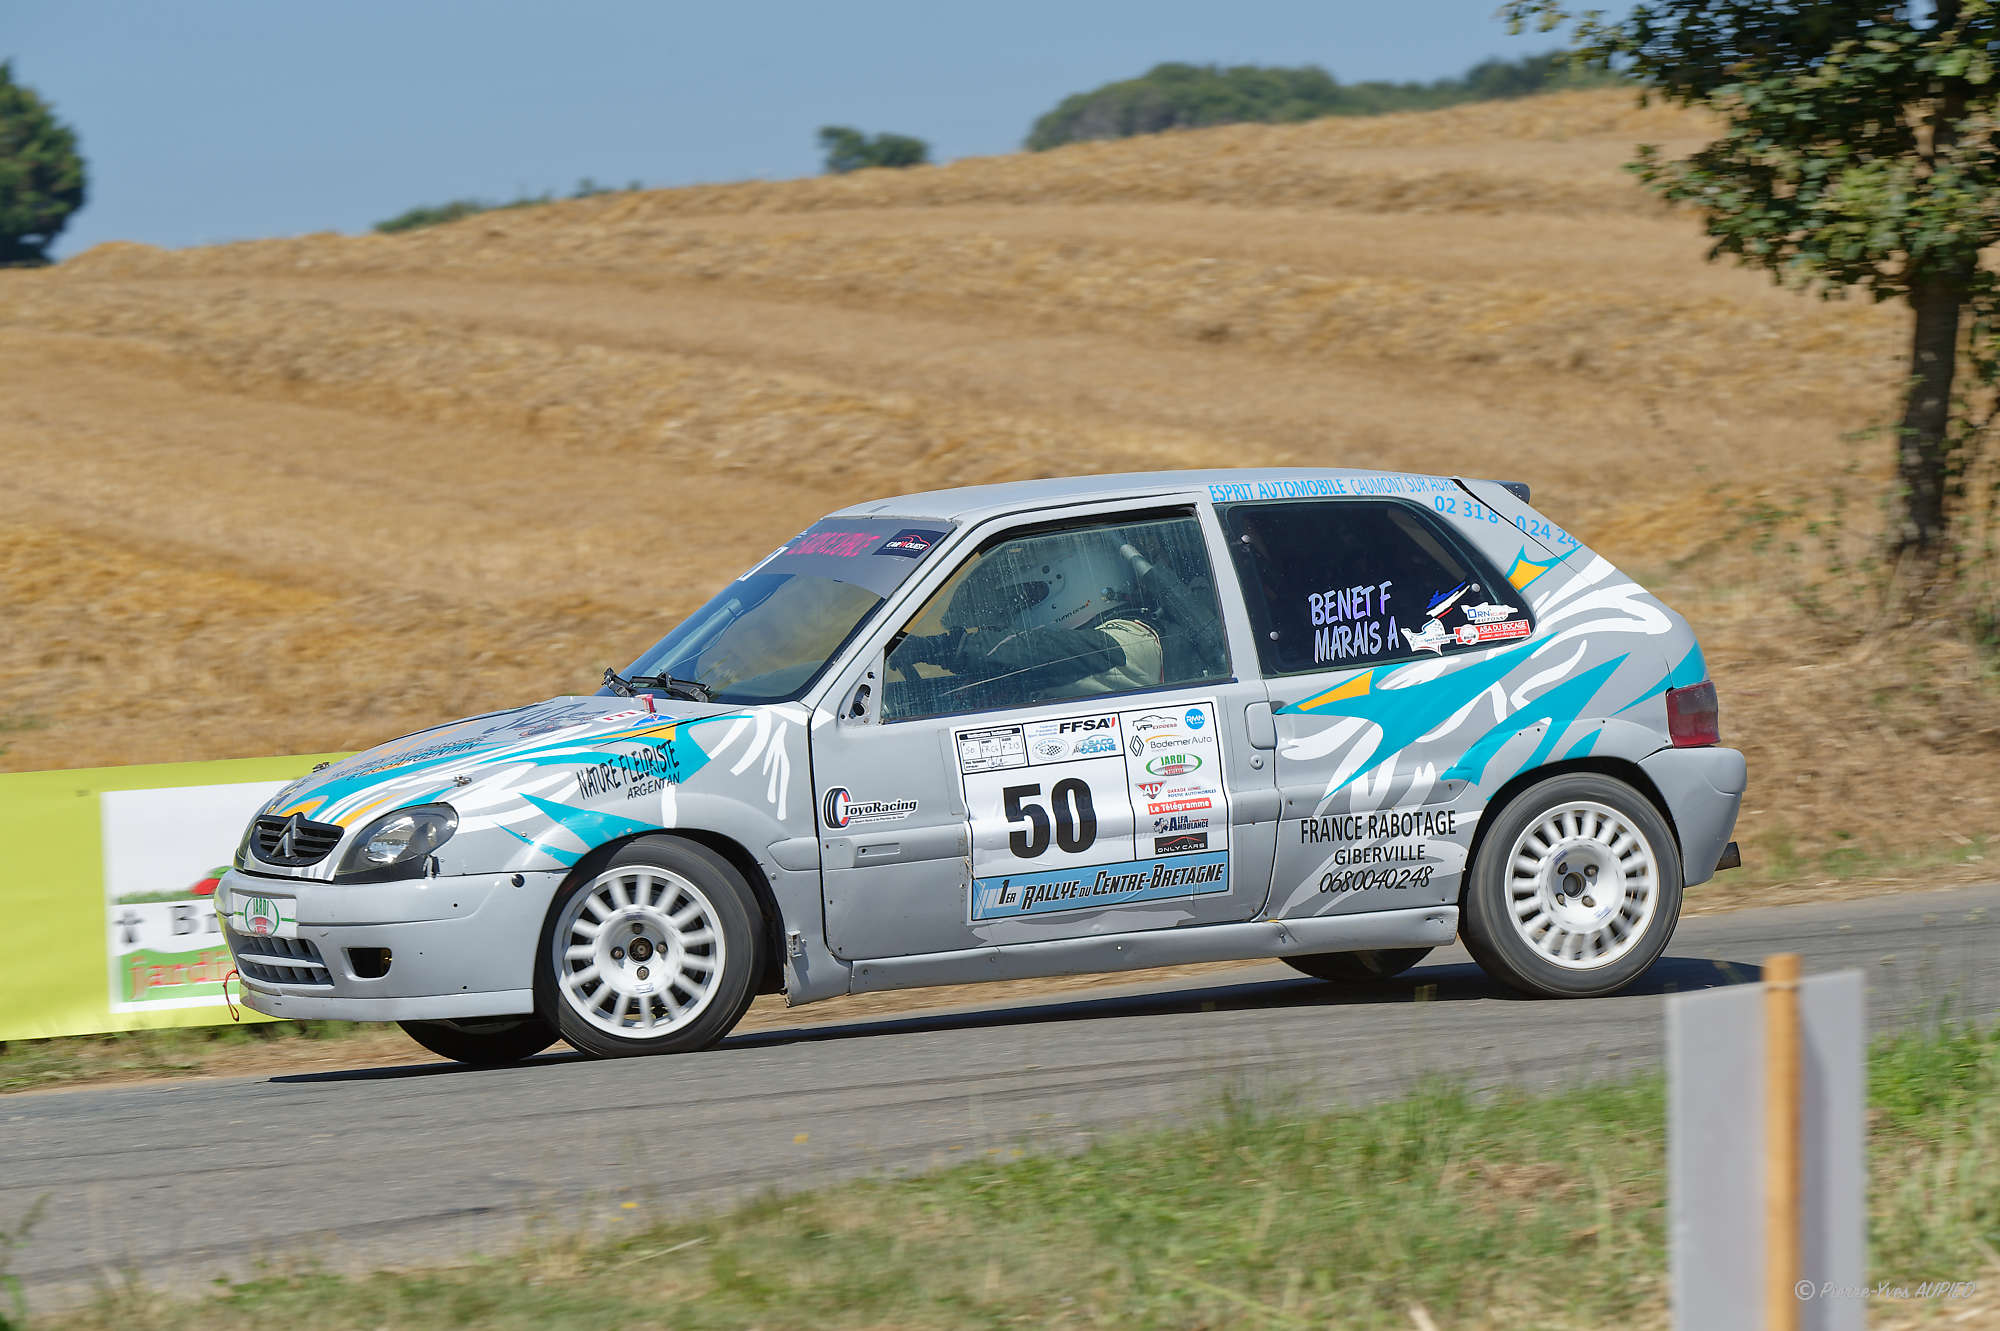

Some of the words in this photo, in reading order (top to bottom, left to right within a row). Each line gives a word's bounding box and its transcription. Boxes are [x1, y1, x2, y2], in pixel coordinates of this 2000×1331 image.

[1208, 482, 1252, 502] ESPRIT
[1257, 478, 1347, 500] AUTOMOBILE
[1350, 477, 1401, 496] CAUMONT
[1405, 477, 1429, 493] SUR
[1434, 495, 1456, 514] 02
[1529, 520, 1552, 540] 24
[1308, 584, 1376, 627] BENET
[1378, 580, 1393, 616] F
[1313, 620, 1382, 664] MARAIS
[1387, 615, 1400, 652] A
[1480, 625, 1493, 633] ASA
[1502, 621, 1527, 631] BOCAGE
[1059, 718, 1110, 734] FFSA
[576, 758, 621, 800] NATURE
[619, 739, 680, 785] FLEURISTE
[1160, 754, 1186, 766] JARDI
[627, 771, 681, 800] ARGENTAN
[1144, 784, 1161, 795] AD
[843, 799, 918, 816] ToyoRacing
[1002, 777, 1098, 859] 50
[1149, 805, 1160, 813] Le
[1160, 799, 1210, 812] Télégramme
[1169, 819, 1209, 831] AMBULANCE
[1300, 815, 1363, 844] FRANCE
[1368, 810, 1457, 839] RABOTAGE
[1334, 844, 1426, 866] GIBERVILLE
[998, 880, 1017, 905] 1ER
[1021, 880, 1080, 911] RALLYE
[1078, 886, 1092, 898] DU
[1092, 864, 1226, 897] CENTRE-BRETAGNE
[1319, 865, 1435, 894] 0680040248
